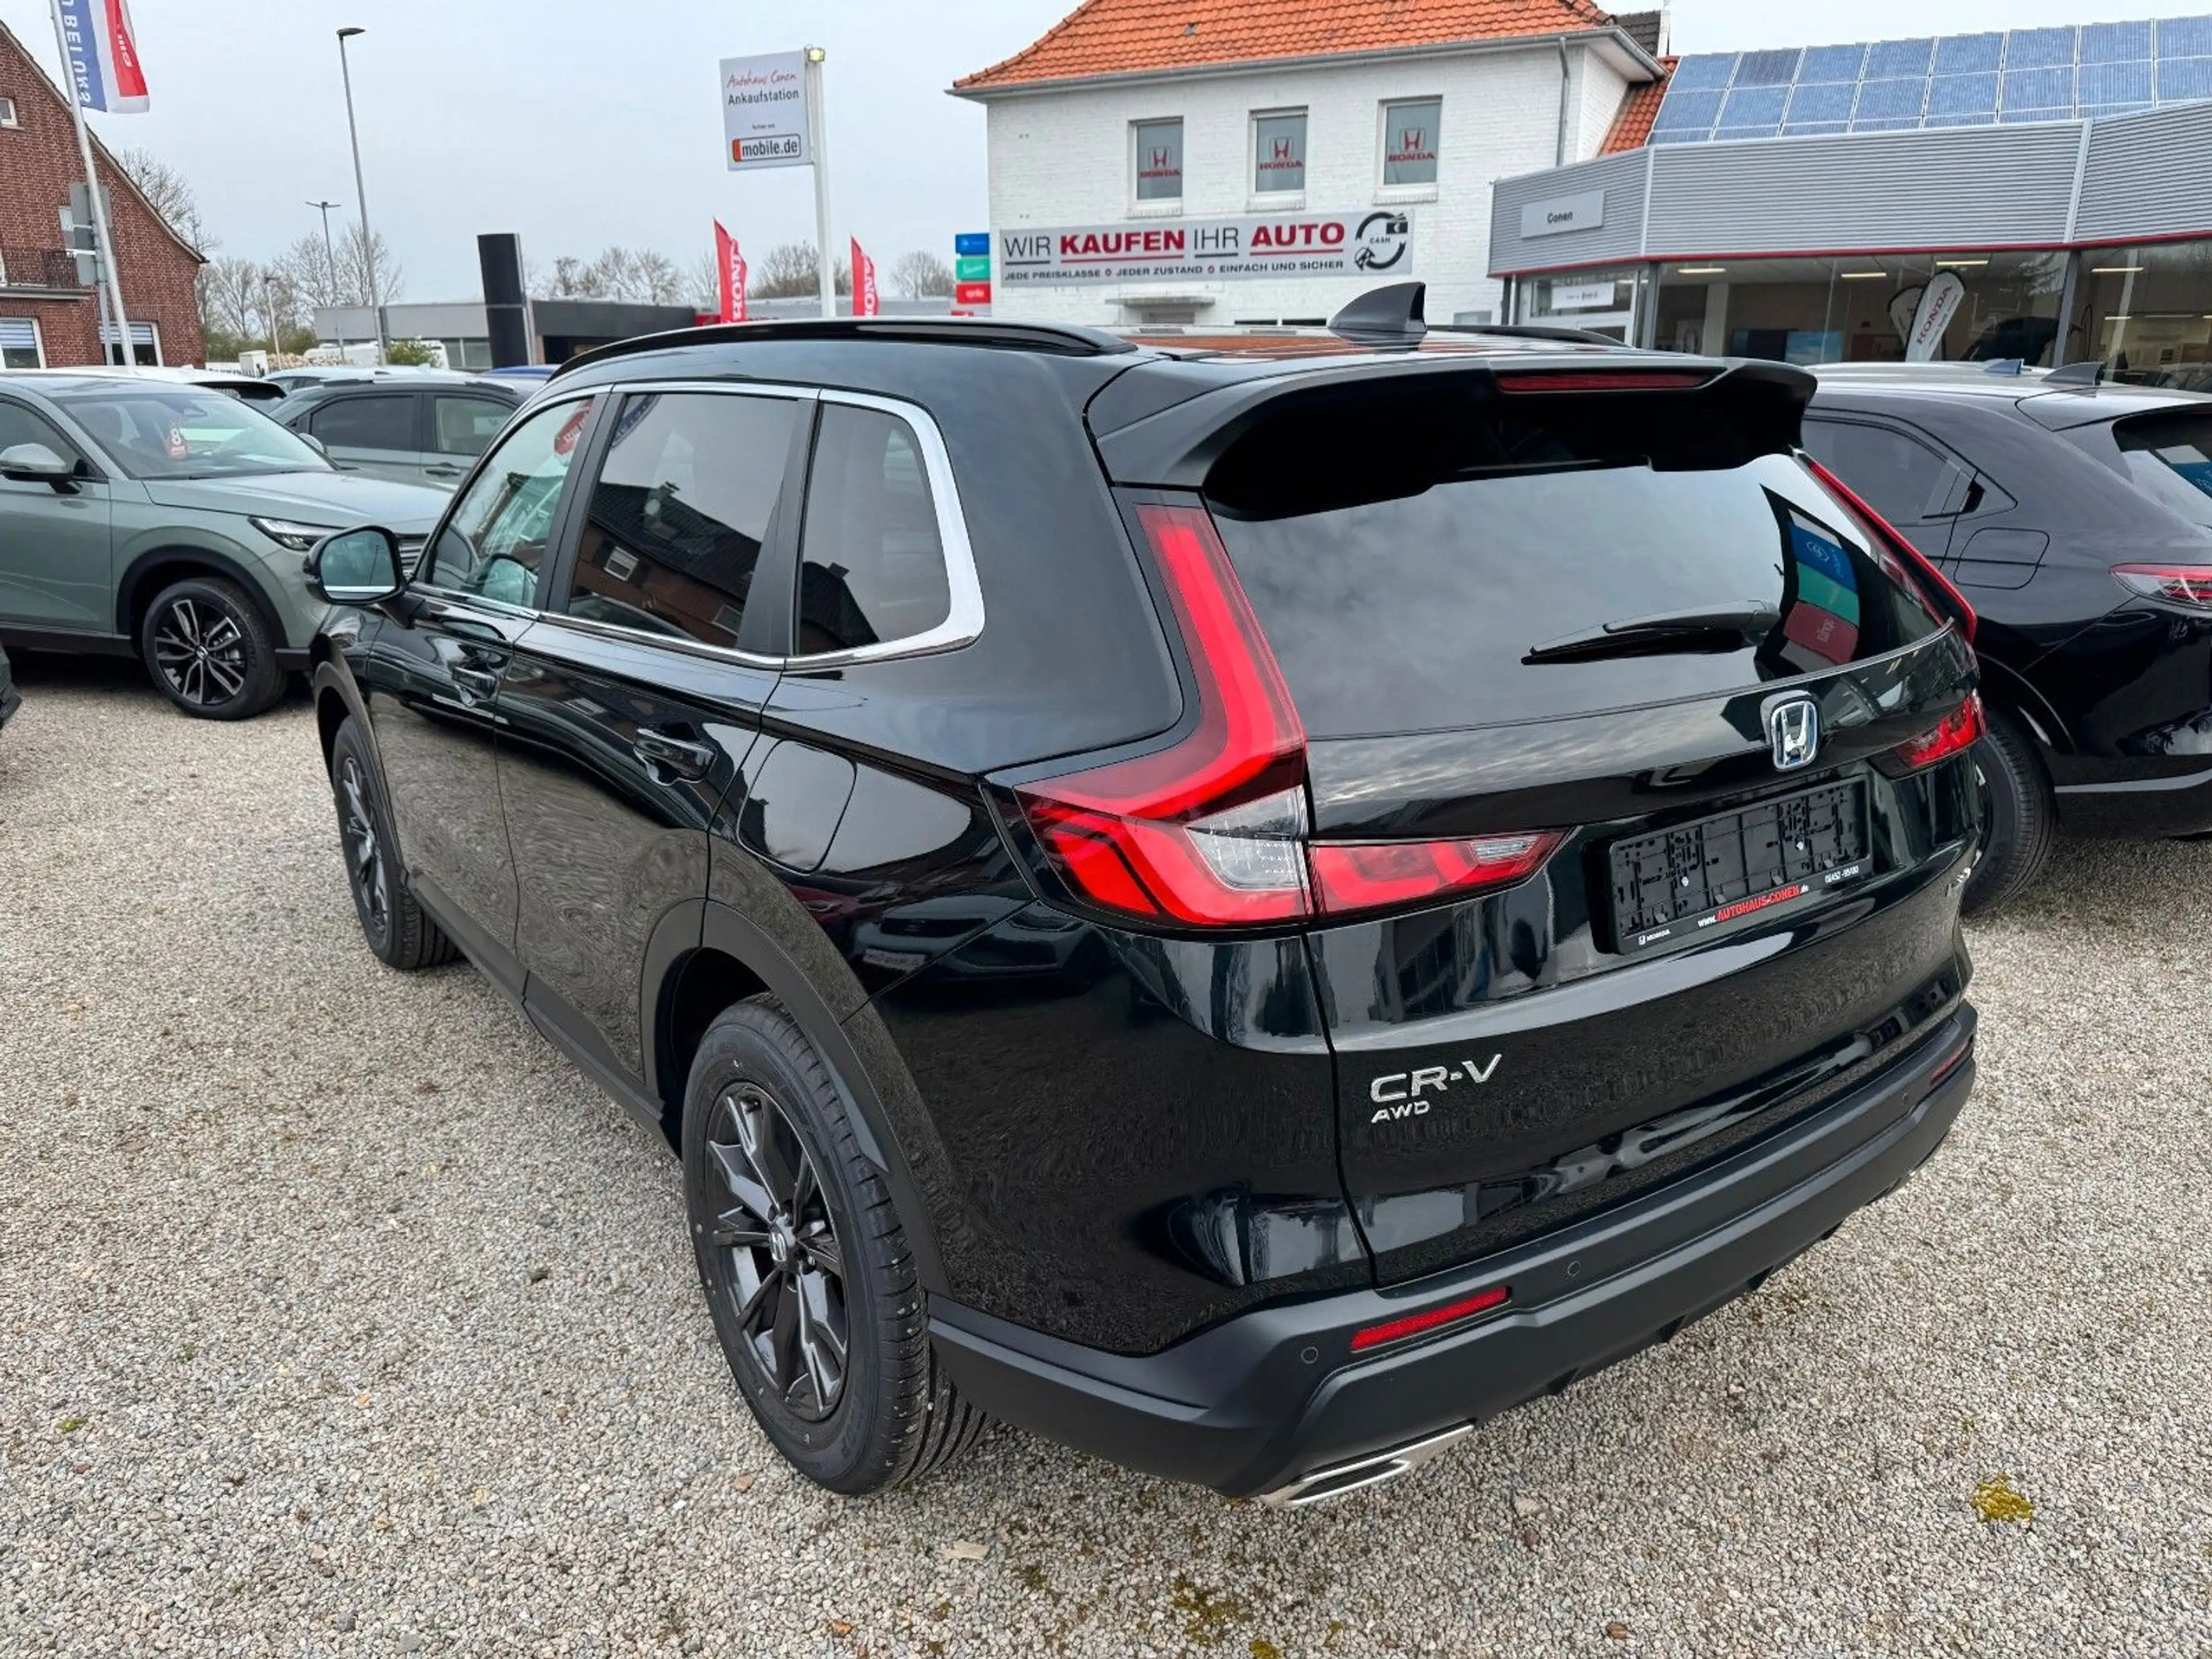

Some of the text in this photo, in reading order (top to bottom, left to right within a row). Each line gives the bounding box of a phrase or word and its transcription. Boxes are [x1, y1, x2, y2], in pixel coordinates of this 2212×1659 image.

[726, 70, 767, 88] Autohaus
[728, 88, 799, 106] Ankaufstation
[742, 139, 798, 156] mobile.de
[1260, 160, 1302, 171] HONDA
[1388, 152, 1434, 162] HONDA
[1547, 211, 1573, 224] Conen
[1005, 222, 1345, 257] WIR KAUFEN IHR AUTO
[1005, 261, 1344, 281] JEDE PREISKLASSE JEDER ZUSTAND EINFACH UND SICHER
[1916, 286, 1953, 344] HONDA
[1370, 1054, 1502, 1103] CR-V
[1371, 1100, 1430, 1123] AWD
